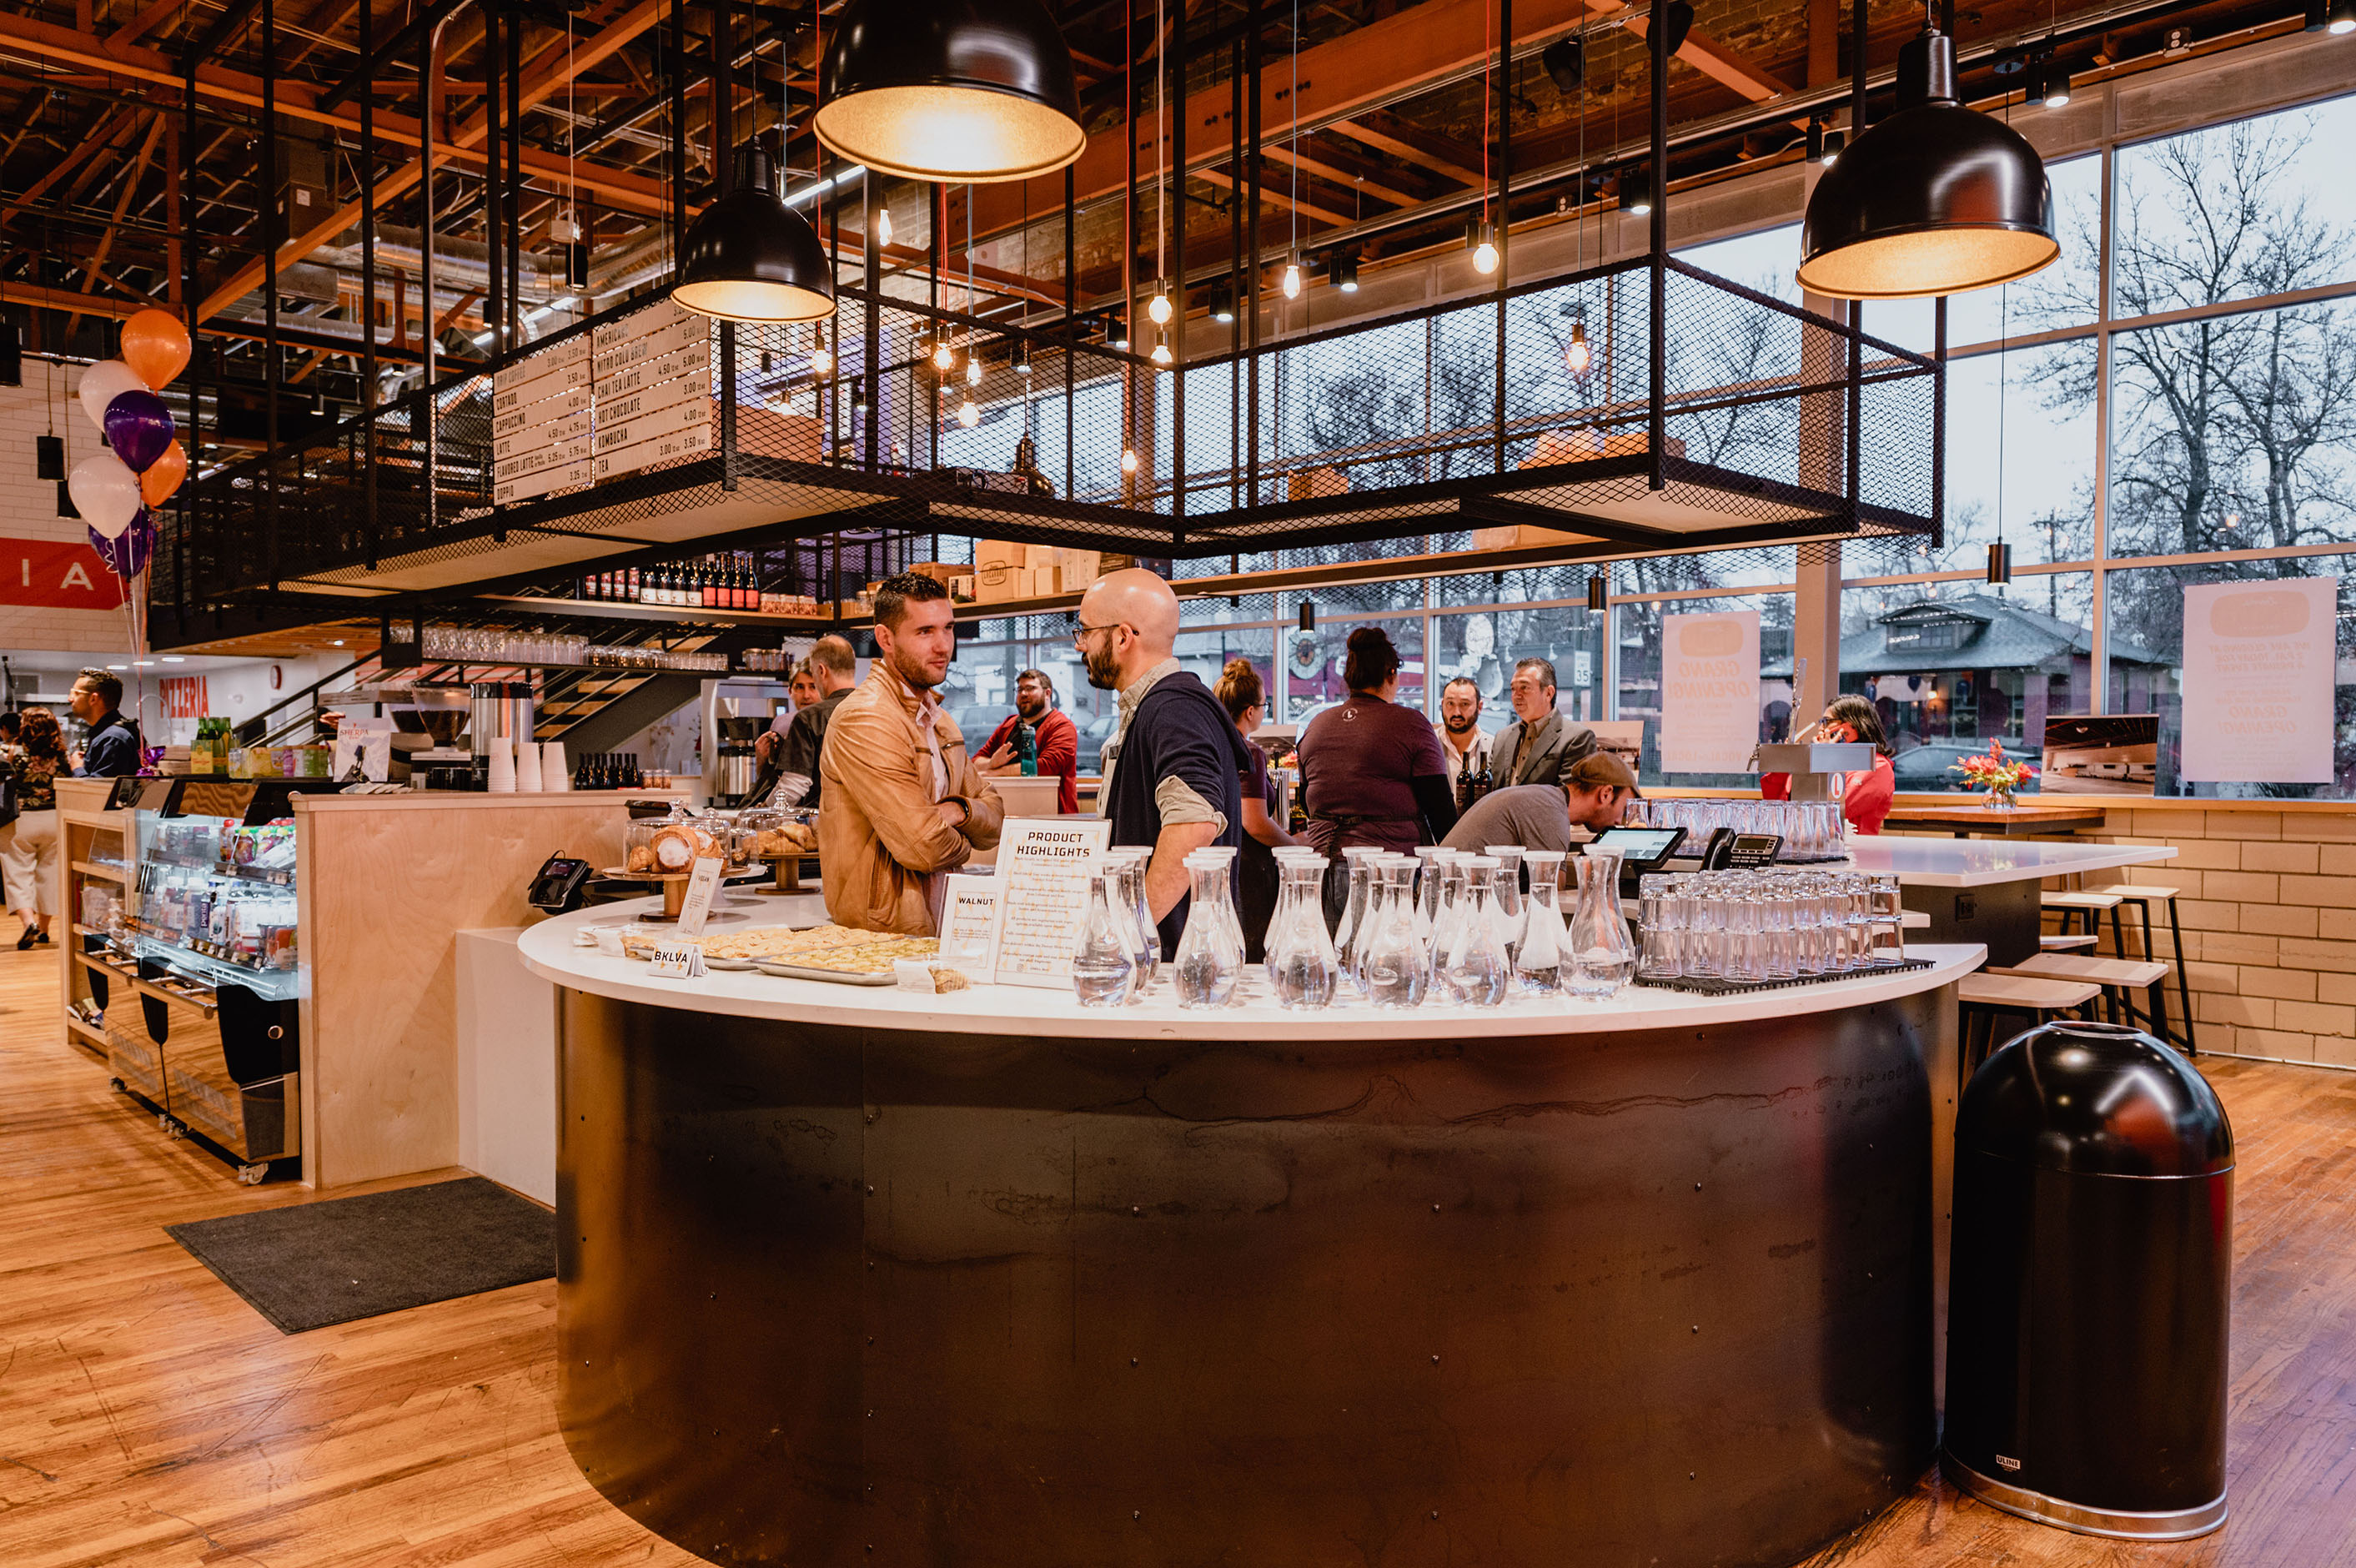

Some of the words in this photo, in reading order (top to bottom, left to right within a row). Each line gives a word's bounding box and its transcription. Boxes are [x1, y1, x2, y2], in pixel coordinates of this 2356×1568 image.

[509, 366, 525, 383] COFFEE
[568, 347, 578, 359] 3.50
[598, 356, 613, 372] NITRO
[615, 350, 628, 367] COLD
[683, 326, 696, 339] 5.00
[497, 392, 517, 410] CORTADO
[568, 372, 578, 384] 3.50
[598, 385, 610, 399] CHAI
[612, 379, 622, 394] TEA
[624, 372, 640, 389] LATTE
[658, 363, 670, 376] 4.50
[683, 354, 695, 367] 5.00
[496, 412, 525, 433] CAPPUCCINO
[568, 397, 579, 407] 4.00
[598, 409, 608, 424] HOT
[610, 397, 640, 420] CHOCOLATE
[683, 382, 696, 395] 3.00
[497, 441, 510, 455] LATTE
[548, 429, 558, 439] 4.50
[569, 422, 579, 432] 4.75
[598, 428, 628, 449] KOMBUCHA
[683, 409, 697, 422] 4.00
[497, 460, 519, 478] FLAVORED
[520, 456, 534, 471] LATTE
[548, 452, 558, 463] 5.25
[569, 446, 579, 457] 5.75
[599, 459, 609, 473] TEA
[660, 444, 671, 456] 3.00
[684, 437, 696, 449] 3.50
[497, 485, 513, 500] DOPPIO
[570, 470, 580, 481] 3.25
[1577, 670, 1588, 682] 35
[159, 676, 209, 718] PIZZERIA
[1017, 845, 1090, 857] HIGHLIGHTS
[1028, 832, 1083, 842] PRODUCT
[655, 951, 688, 962] BKLVA
[1997, 1456, 2019, 1468] ULINE
